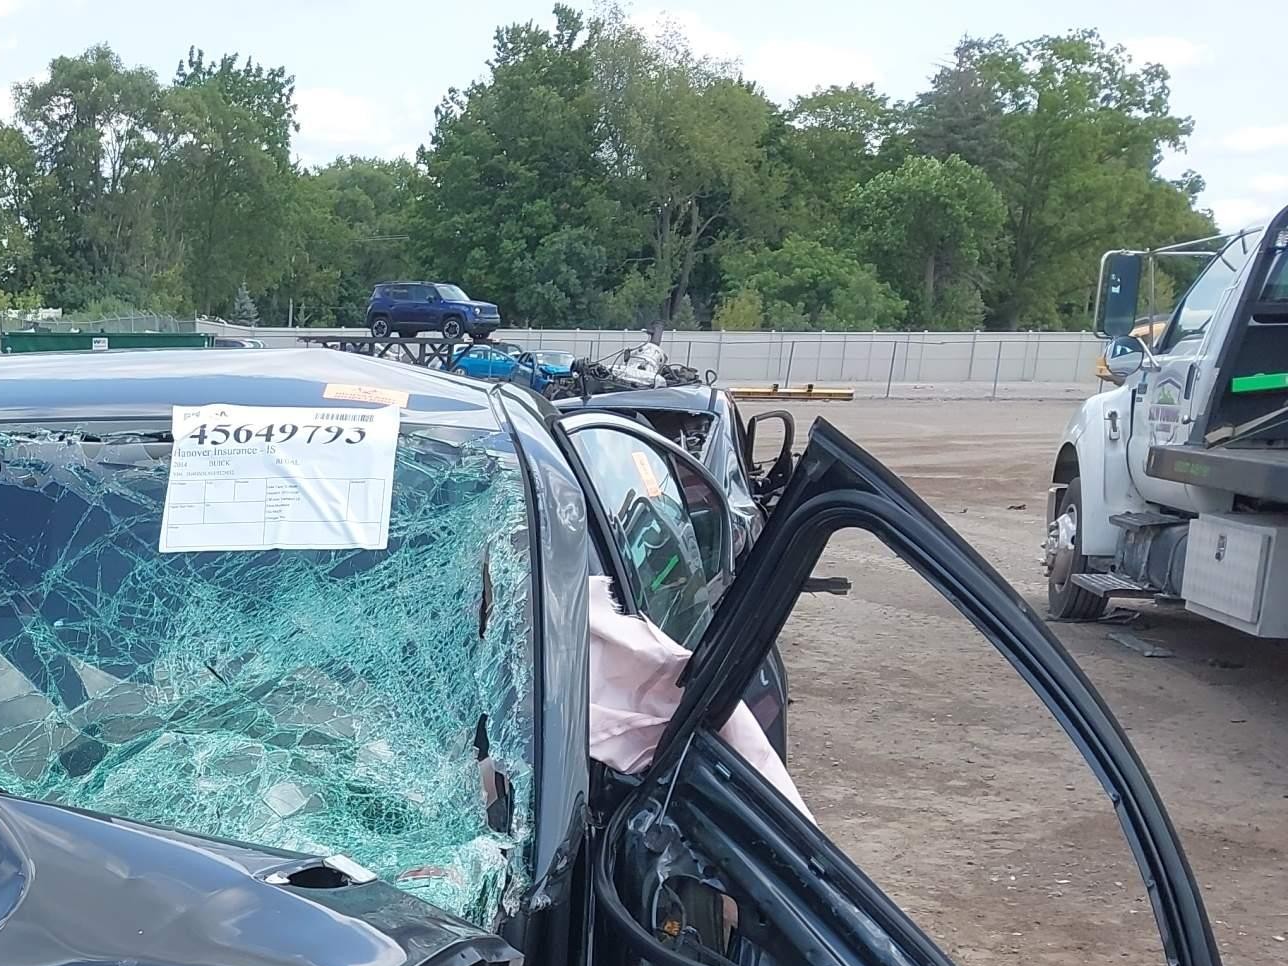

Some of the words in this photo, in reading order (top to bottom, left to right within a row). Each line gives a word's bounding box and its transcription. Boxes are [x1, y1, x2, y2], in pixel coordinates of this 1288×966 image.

[188, 423, 367, 446] 45649793
[173, 448, 211, 458] Hanover
[213, 446, 258, 457] Insurance
